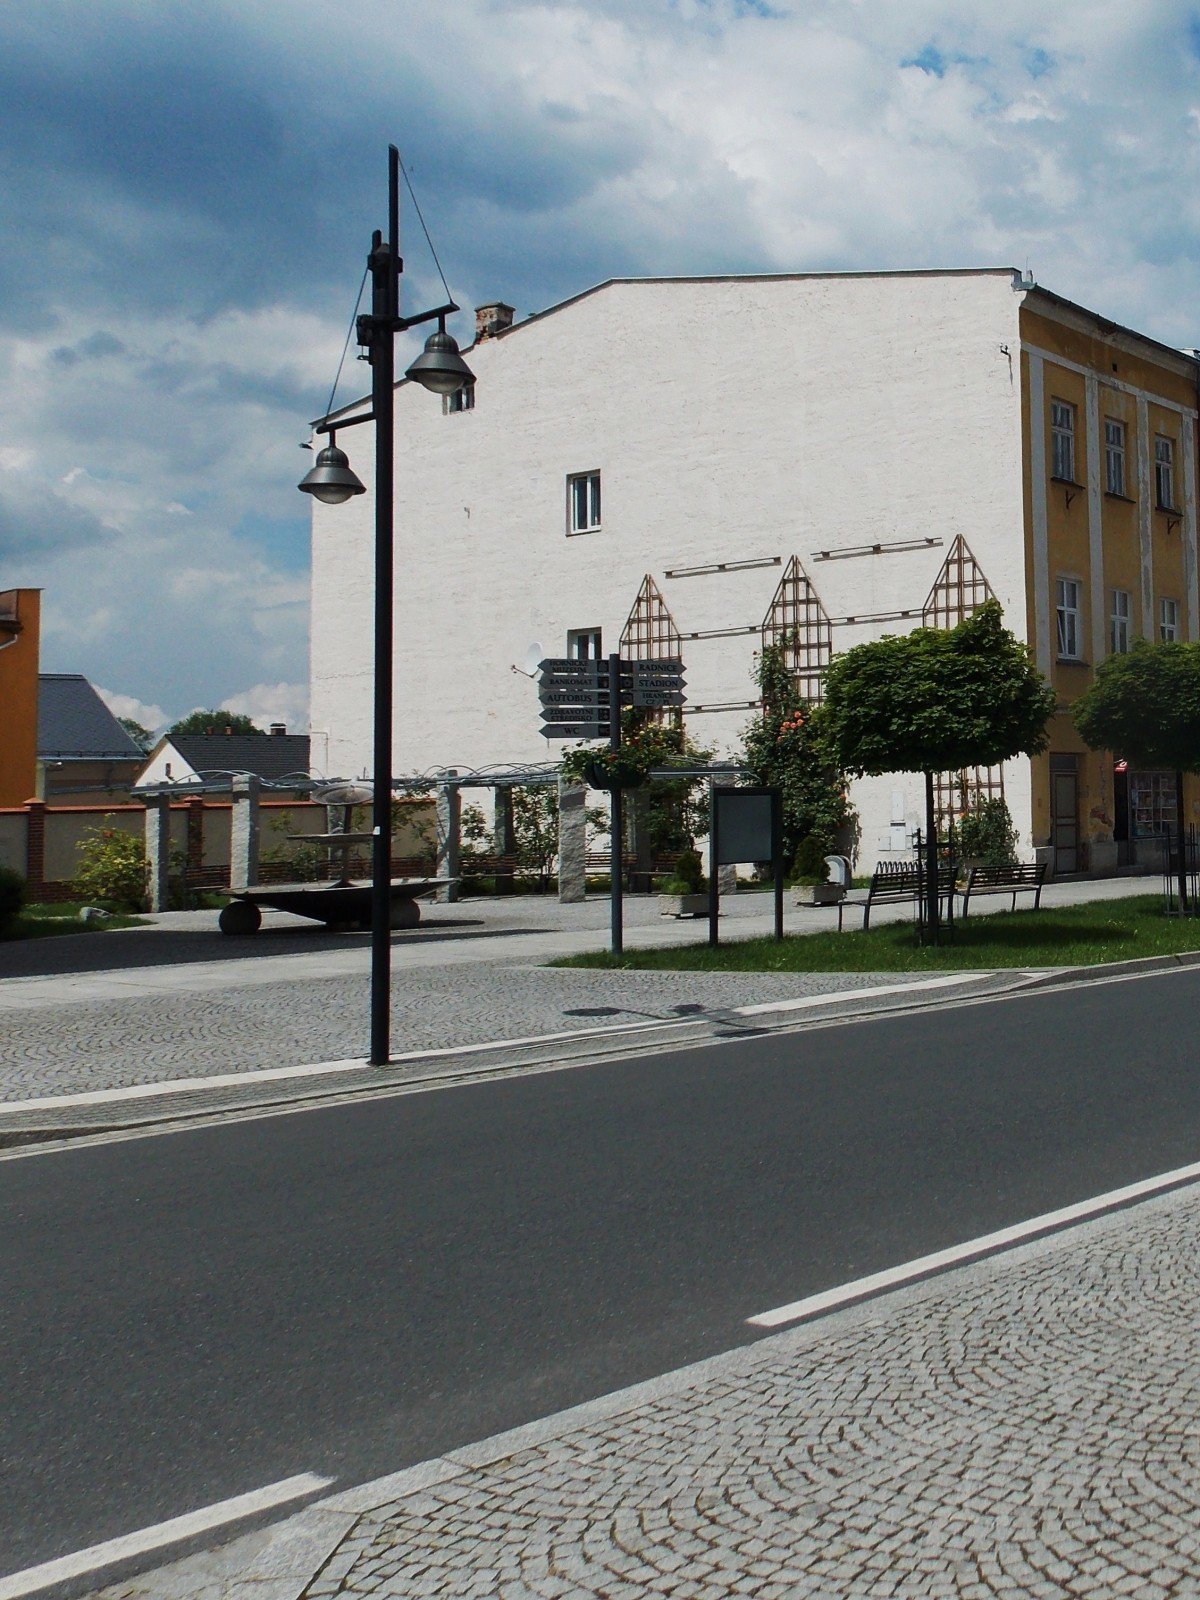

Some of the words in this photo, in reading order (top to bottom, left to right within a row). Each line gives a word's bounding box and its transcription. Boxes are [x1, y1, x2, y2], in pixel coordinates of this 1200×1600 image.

[639, 664, 678, 672] RADNICE
[547, 694, 592, 702] AUTOBUS
[564, 727, 580, 735] WC
